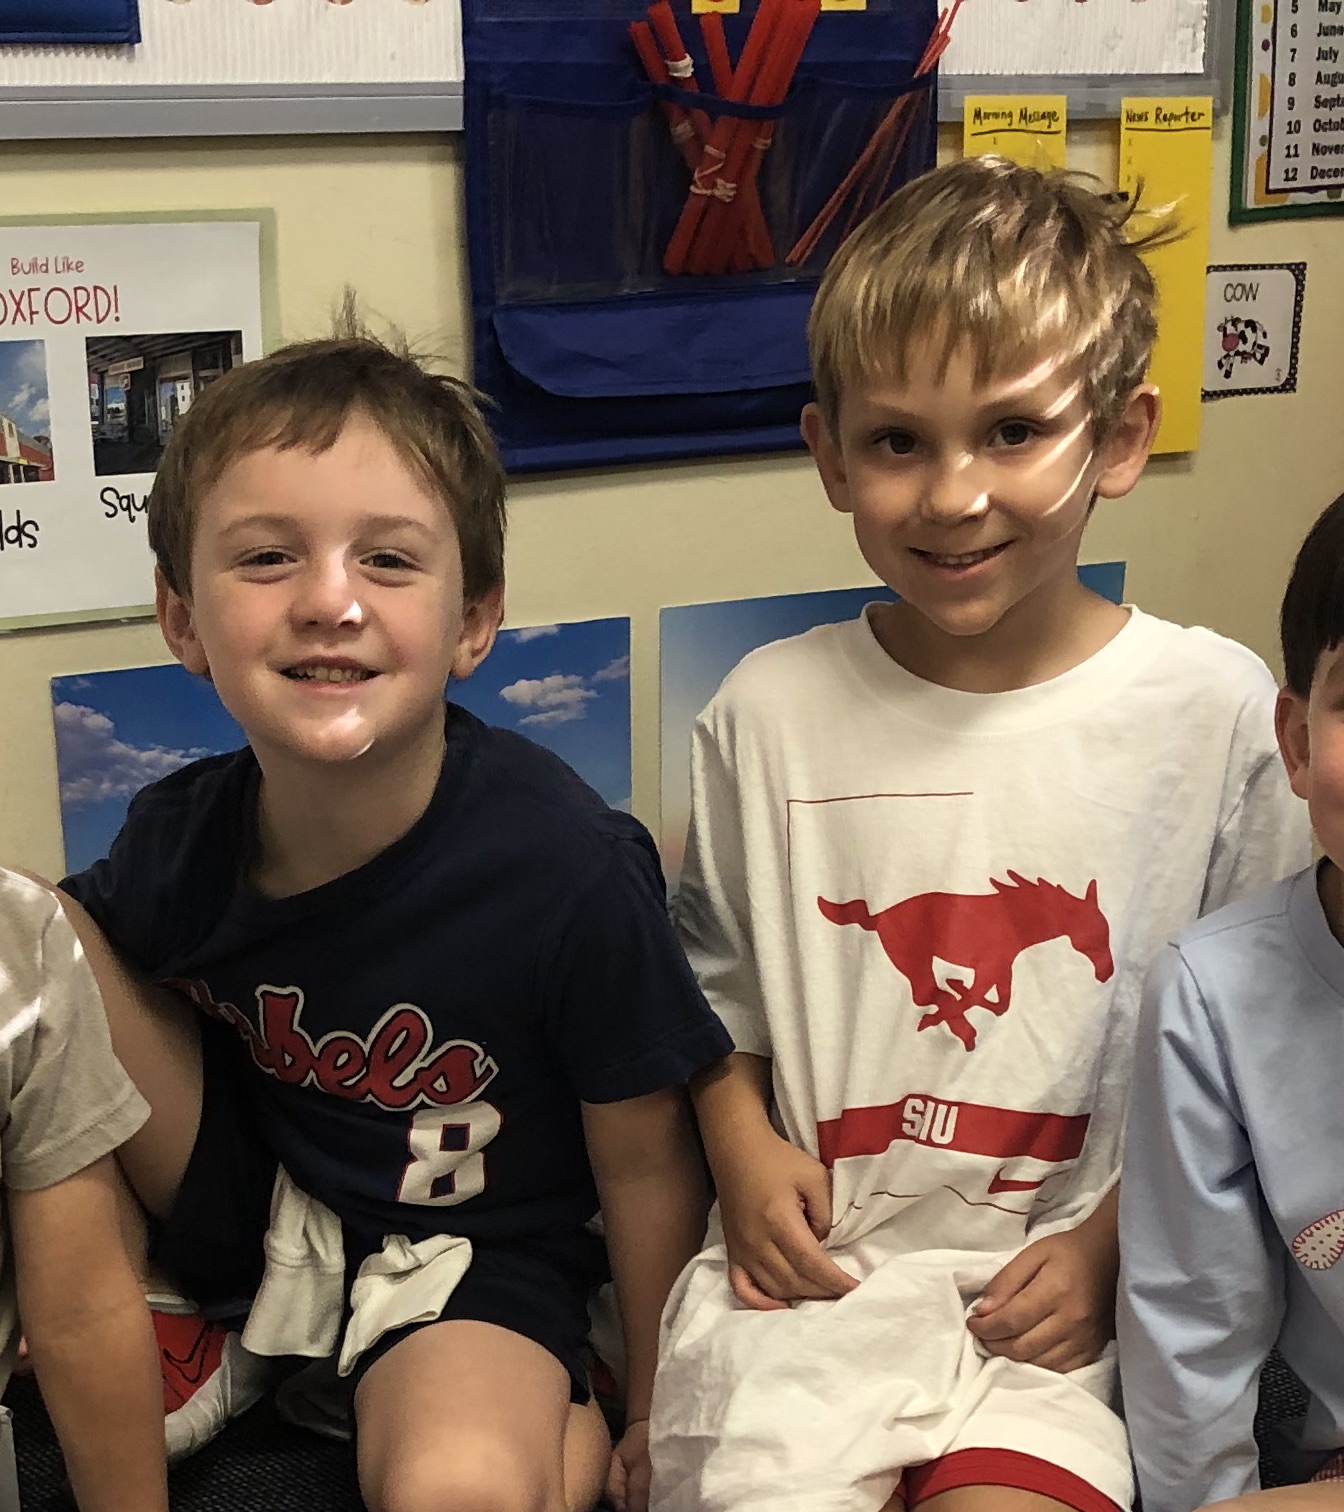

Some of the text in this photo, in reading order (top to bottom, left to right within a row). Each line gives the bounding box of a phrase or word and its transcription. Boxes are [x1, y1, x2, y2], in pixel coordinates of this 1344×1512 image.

[1290, 0, 1299, 14] 5
[1317, 0, 1343, 15] May
[1290, 23, 1298, 38] 6
[1316, 22, 1344, 37] June
[1289, 48, 1297, 62] 7
[1315, 46, 1340, 63] July
[1287, 72, 1297, 87] 8
[1287, 96, 1296, 111] 9
[973, 106, 1060, 129] Morning Message
[1125, 106, 1206, 128] News Reporter
[1285, 119, 1302, 135] 10
[1284, 143, 1300, 159] 11
[1283, 167, 1299, 182] 12
[10, 255, 85, 276] Build Like
[396, 1099, 503, 1207] 8
